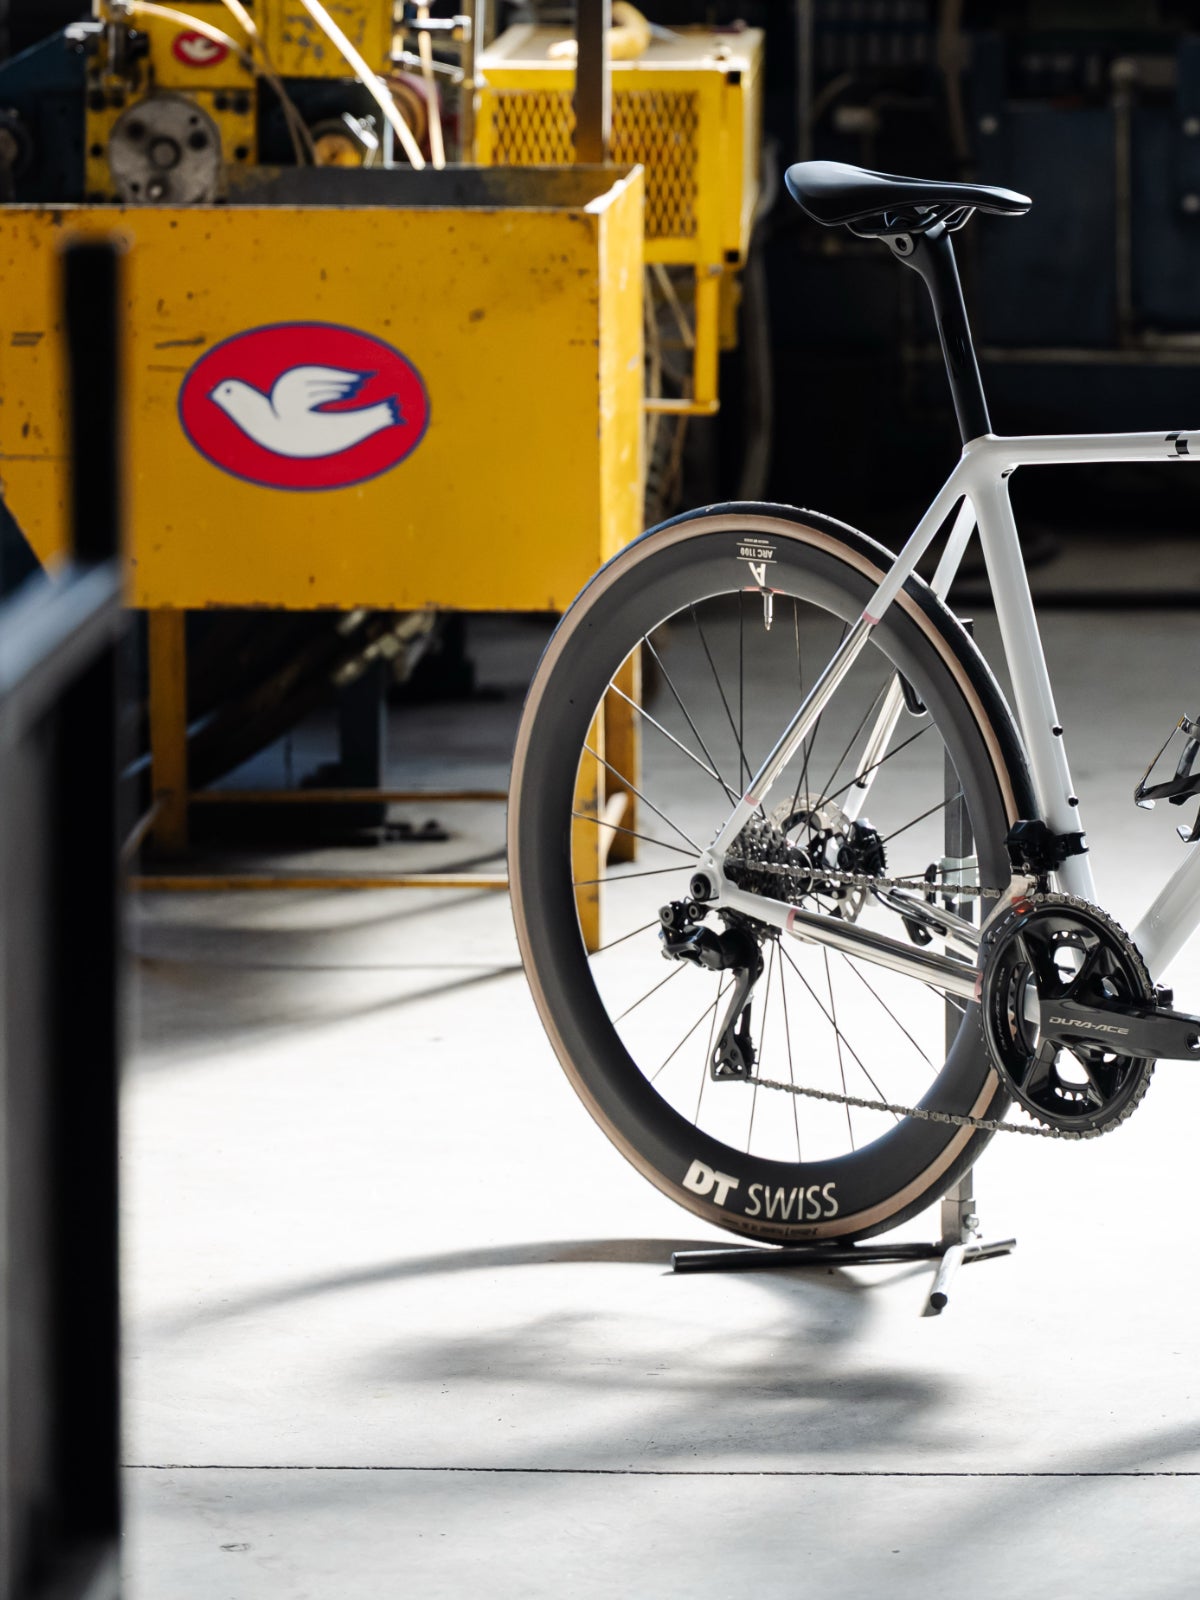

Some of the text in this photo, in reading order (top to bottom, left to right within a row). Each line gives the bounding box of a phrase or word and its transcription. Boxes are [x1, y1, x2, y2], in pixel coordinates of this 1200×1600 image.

[757, 549, 773, 559] ARC
[1049, 1016, 1130, 1035] DURA-ACE
[682, 1159, 840, 1220] DT SWISS
